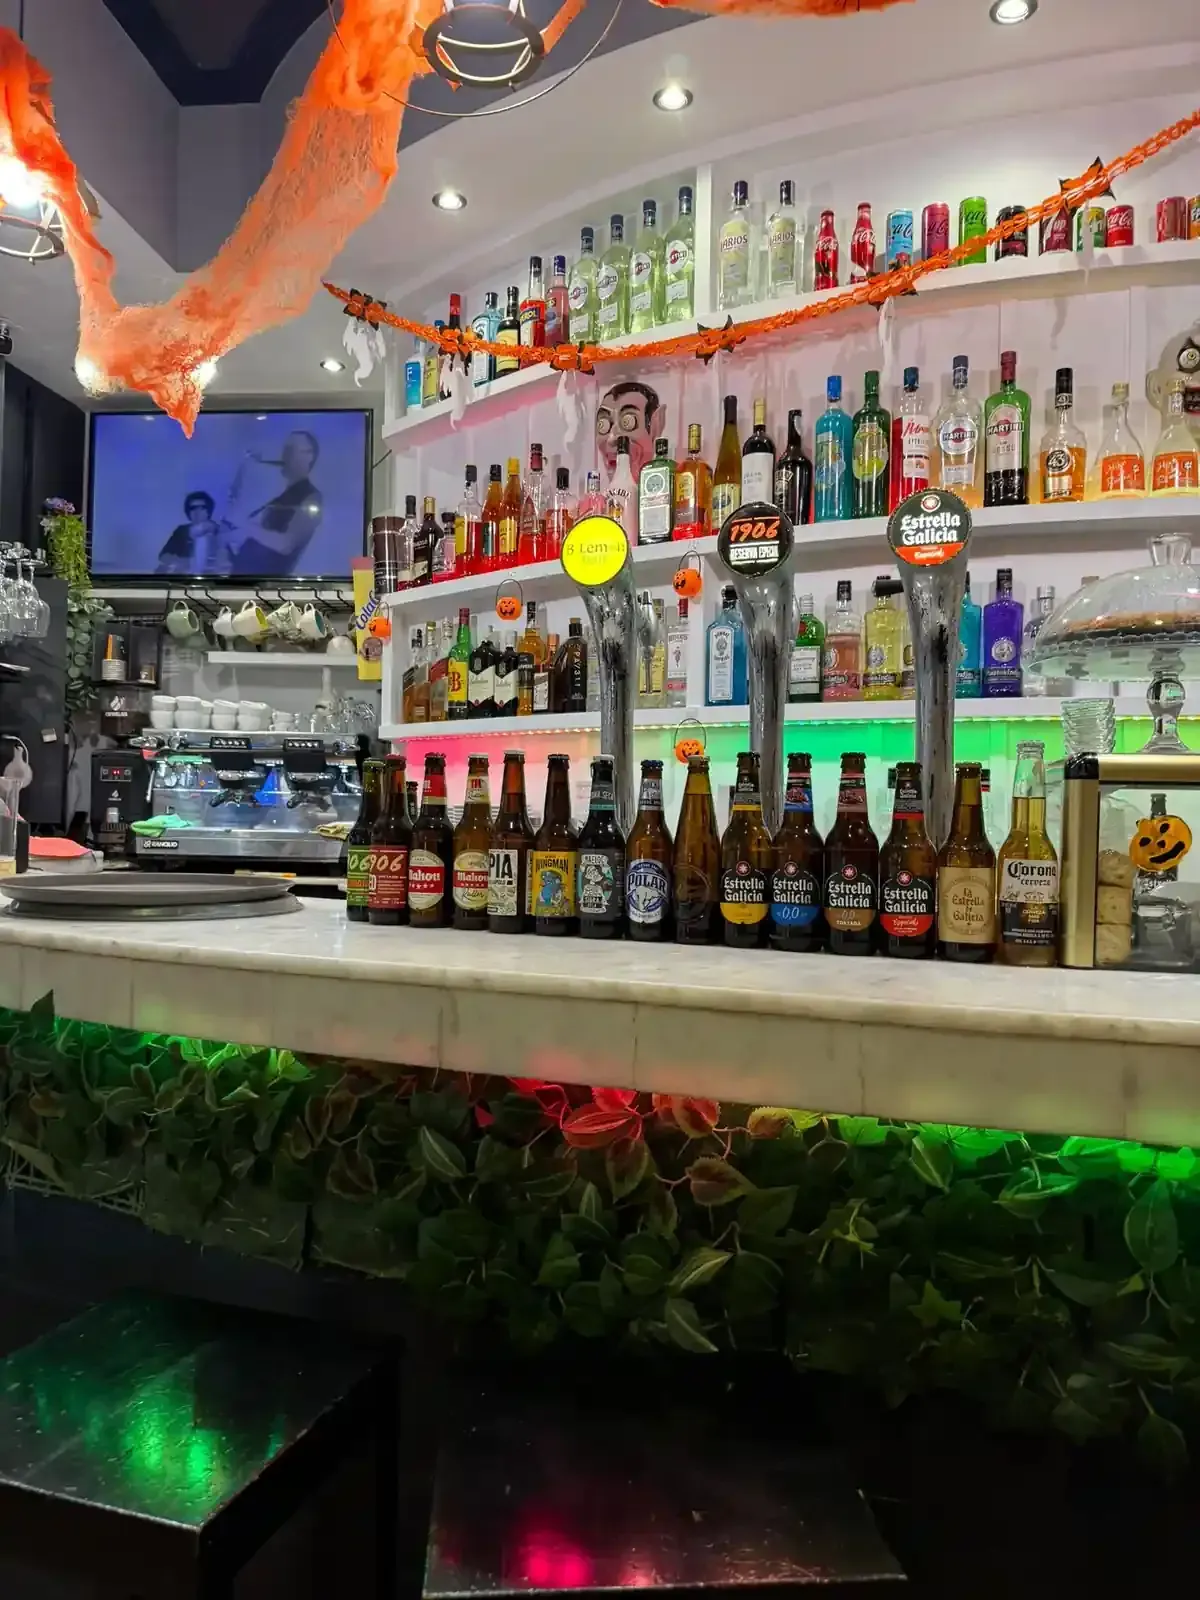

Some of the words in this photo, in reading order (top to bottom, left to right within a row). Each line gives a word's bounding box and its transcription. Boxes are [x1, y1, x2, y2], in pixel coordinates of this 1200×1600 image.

[987, 421, 1024, 435] MARTINI
[900, 512, 961, 531] Estrella
[730, 520, 780, 542] 1906
[902, 527, 958, 546] Galicia
[627, 873, 667, 894] POLAR
[723, 876, 765, 890] Estrella
[772, 876, 814, 891] Estrella
[828, 881, 872, 895] Estrella
[724, 889, 763, 903] Galicia
[773, 890, 812, 904] Galicia
[884, 887, 928, 900] Estrella
[828, 894, 870, 908] Galicia
[884, 900, 927, 913] Galicia
